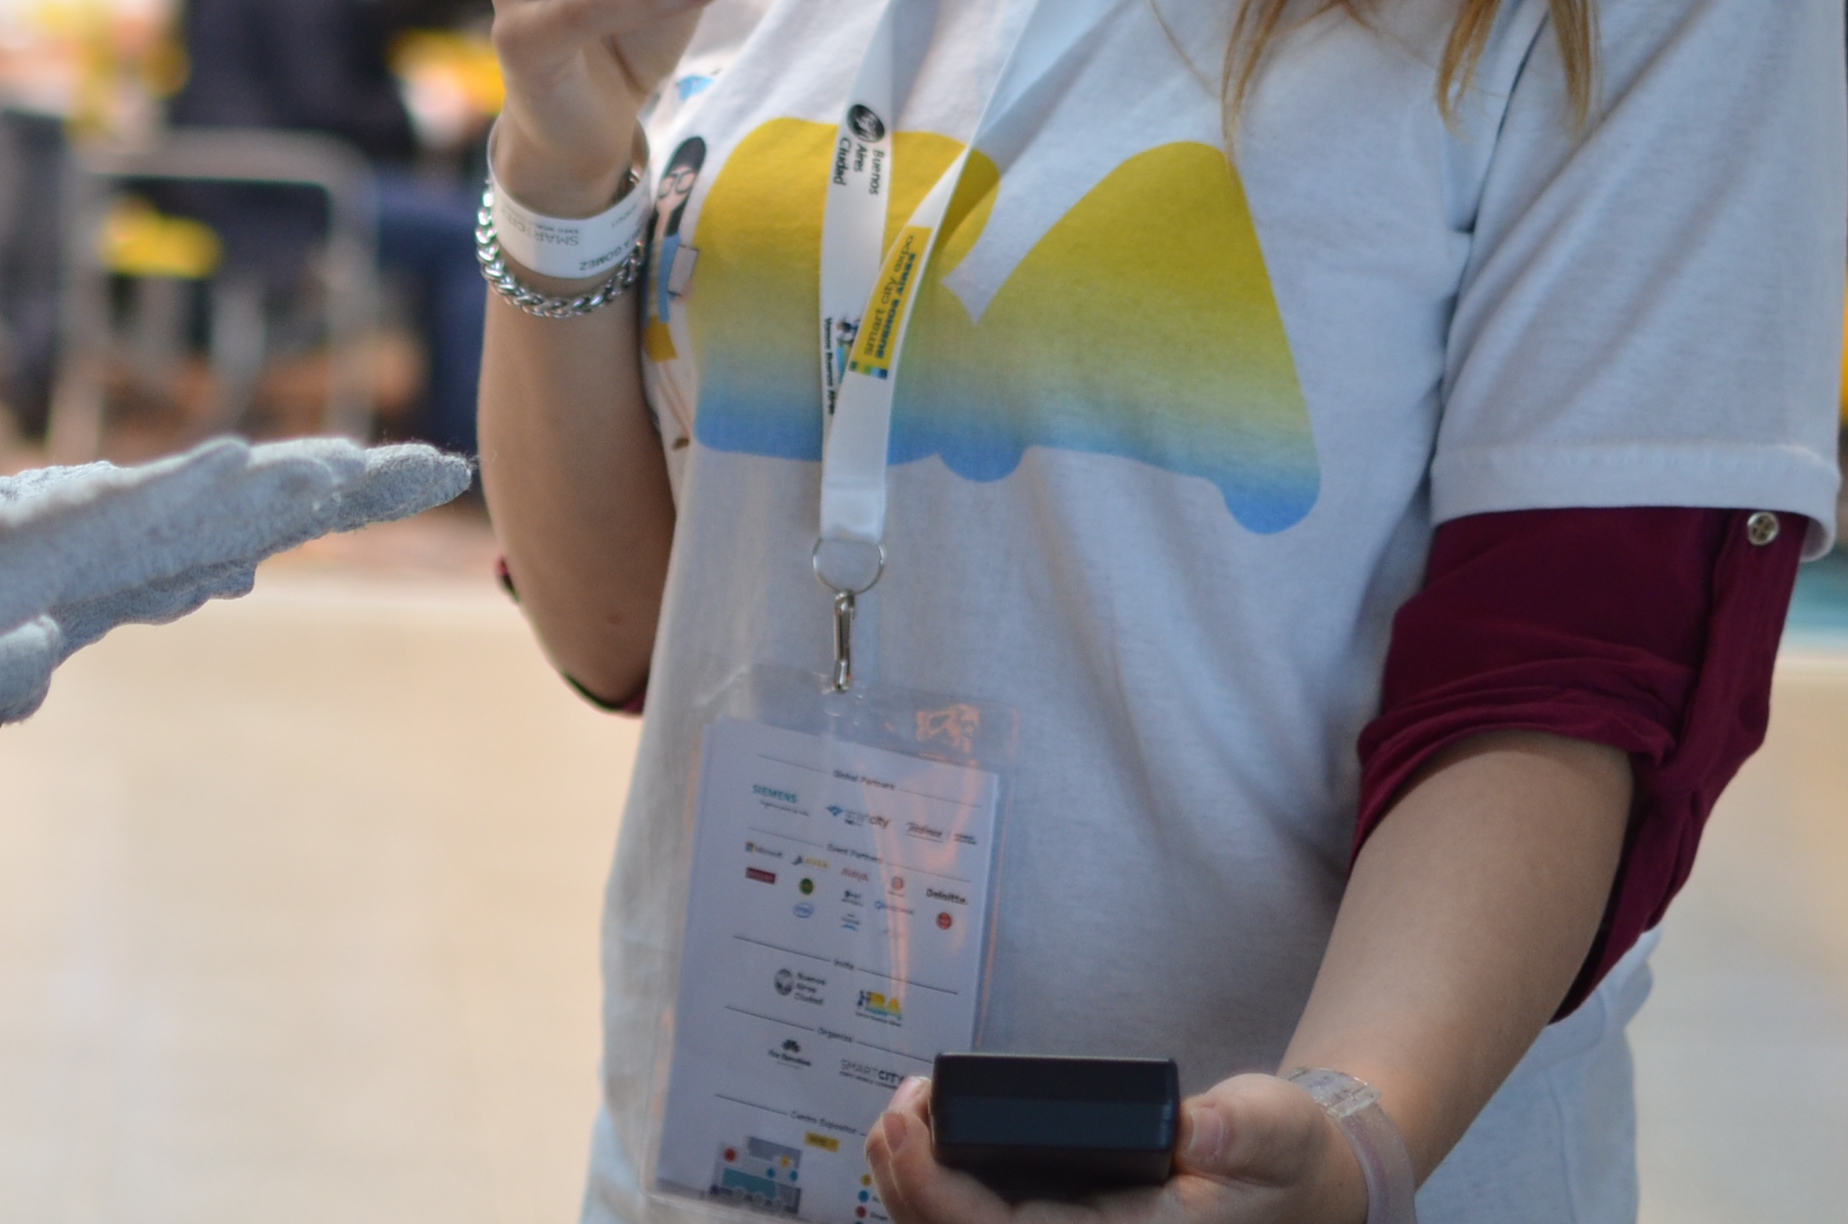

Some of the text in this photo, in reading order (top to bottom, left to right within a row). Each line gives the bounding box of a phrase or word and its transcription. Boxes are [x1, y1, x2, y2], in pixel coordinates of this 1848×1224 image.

[833, 137, 851, 185] Ciudad
[853, 142, 868, 172] Aires
[869, 149, 885, 195] Buenos
[864, 235, 914, 356] smart city expo
[752, 784, 798, 804] SIEMENS
